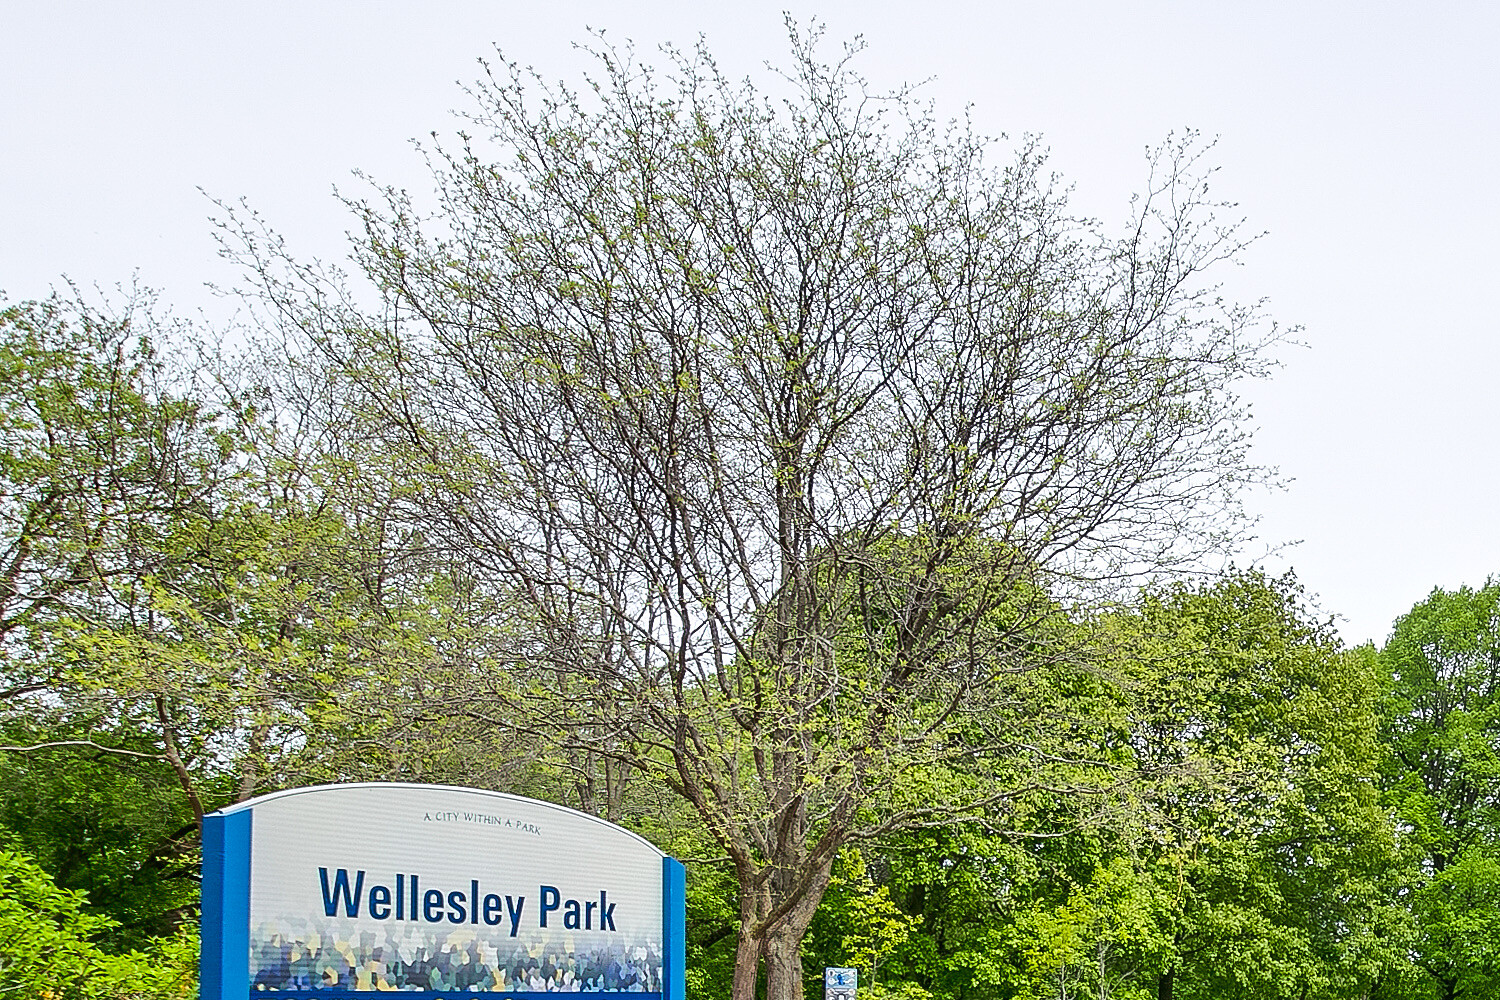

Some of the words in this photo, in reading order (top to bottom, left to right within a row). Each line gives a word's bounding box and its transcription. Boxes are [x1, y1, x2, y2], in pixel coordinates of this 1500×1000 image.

[423, 812, 432, 821] A
[435, 812, 459, 822] CITY
[463, 812, 501, 825] WITHIN
[504, 819, 512, 827] A
[515, 820, 541, 835] PARK
[318, 866, 526, 938] Wellesley
[539, 884, 617, 932] Park
